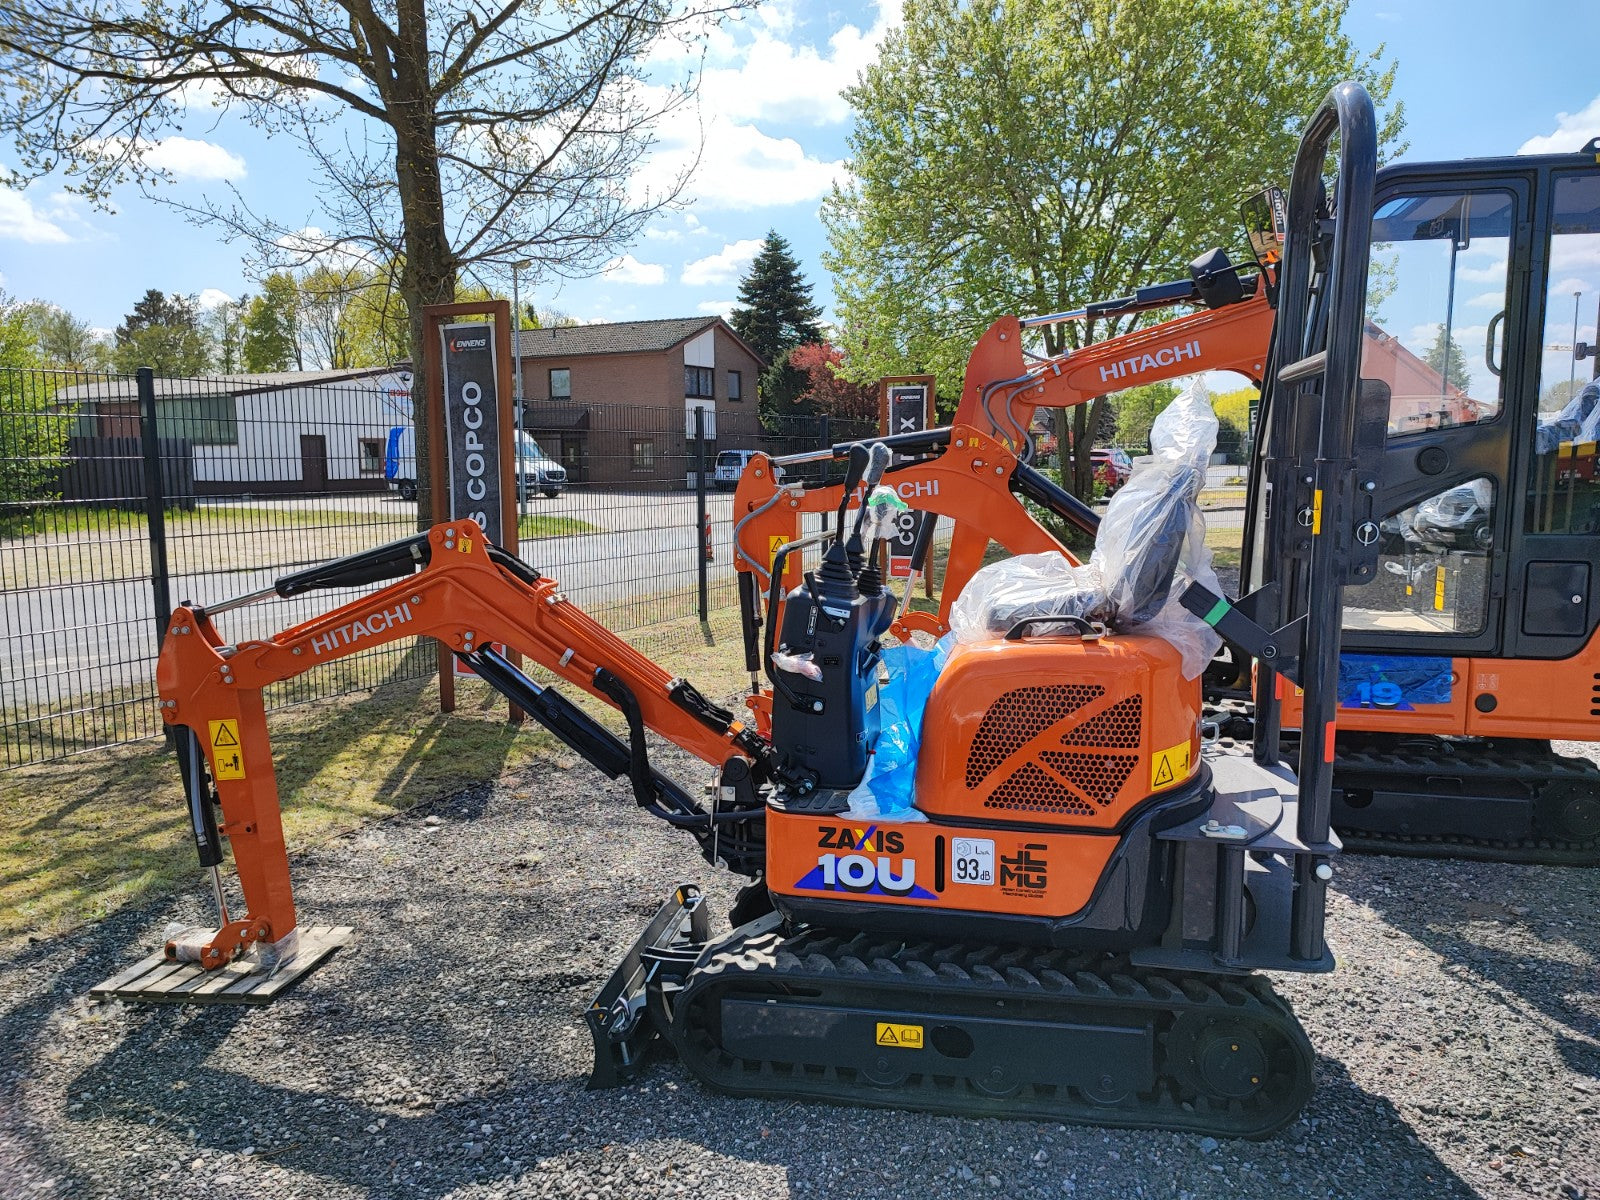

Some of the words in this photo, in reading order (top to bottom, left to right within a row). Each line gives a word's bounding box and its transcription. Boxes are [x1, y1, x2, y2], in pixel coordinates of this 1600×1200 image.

[1099, 340, 1202, 382] HITACHI
[462, 381, 487, 501] COPCO
[311, 602, 413, 655] HITACHI
[1357, 681, 1402, 707] 19
[818, 825, 905, 854] ZAXIS
[818, 853, 916, 894] 10U
[957, 857, 979, 880] 93
[980, 870, 991, 881] dB
